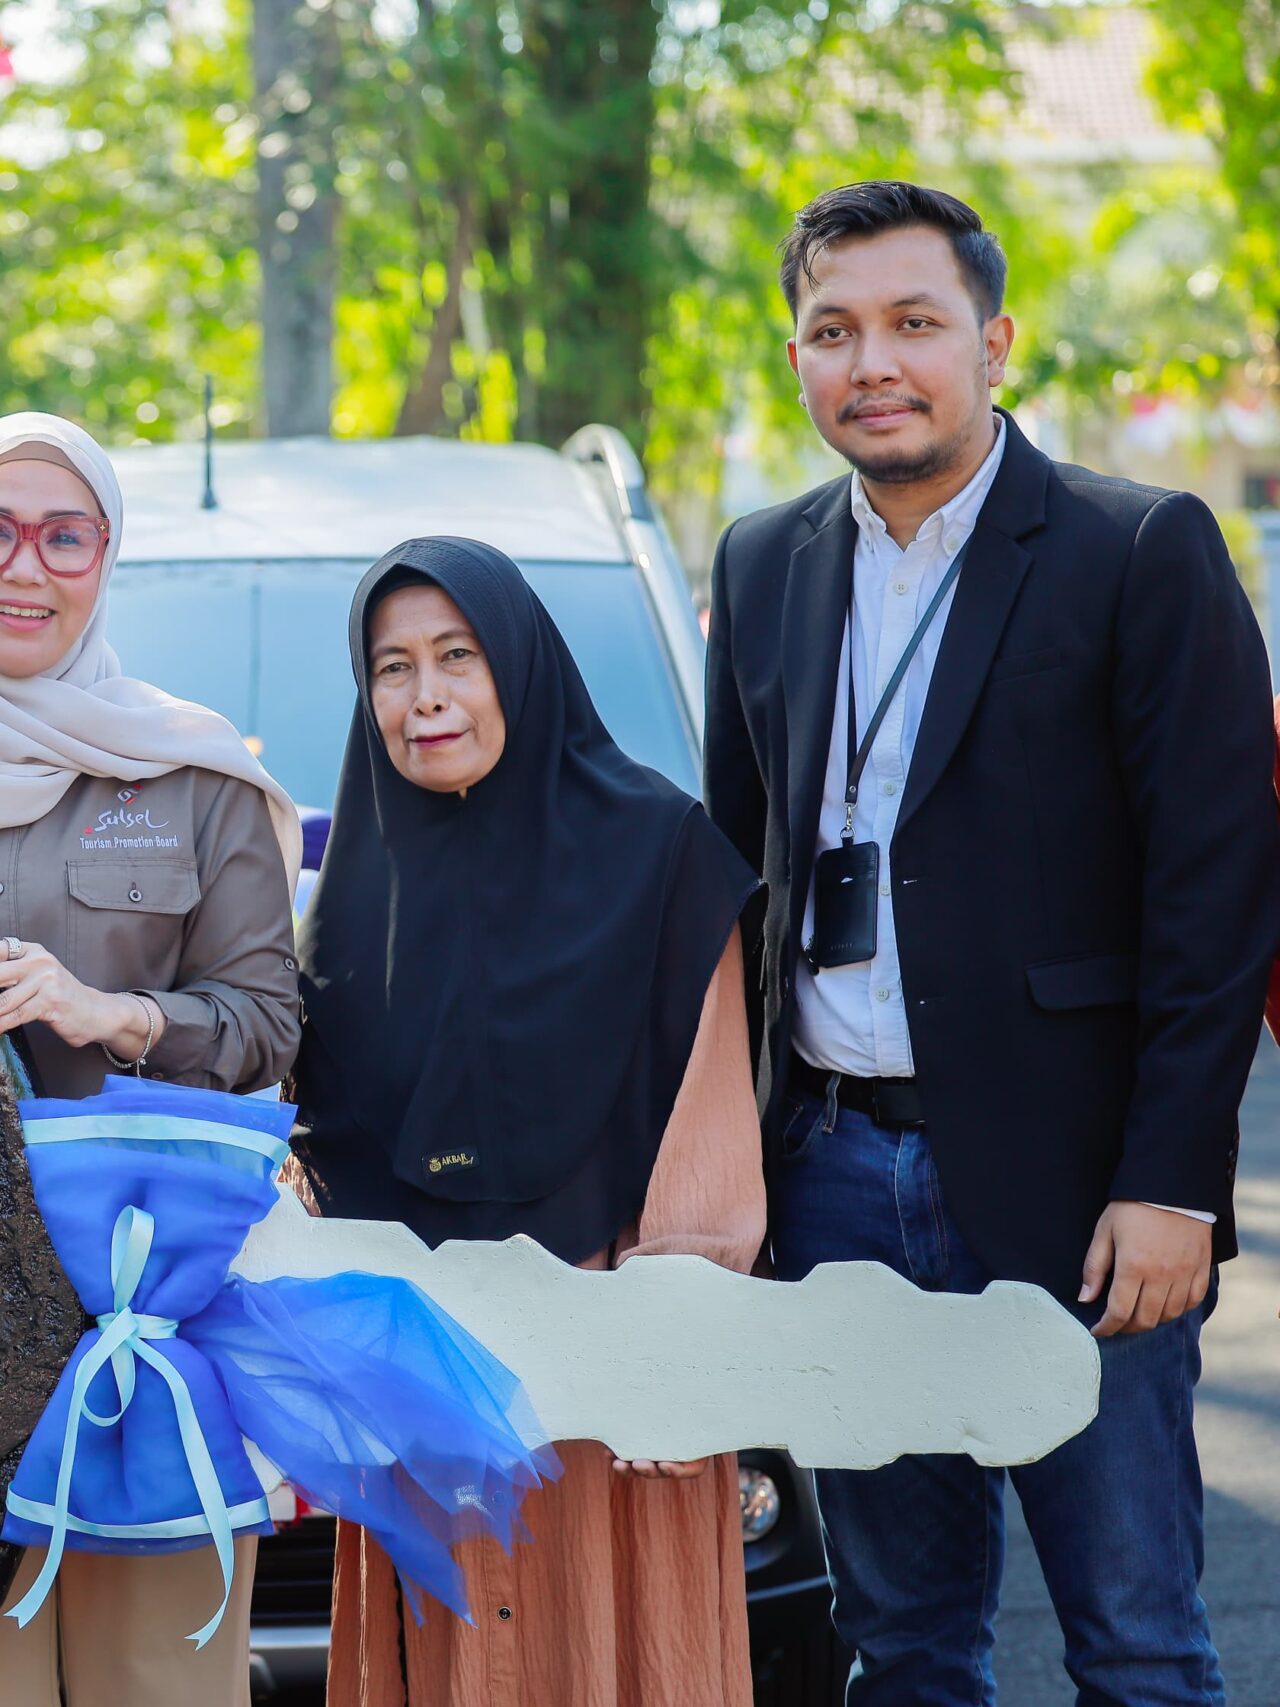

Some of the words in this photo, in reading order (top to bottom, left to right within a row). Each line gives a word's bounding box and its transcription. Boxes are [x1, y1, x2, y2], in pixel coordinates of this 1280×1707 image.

[80, 837, 112, 849] Tourism
[113, 836, 154, 849] Promotion
[155, 835, 178, 847] Board
[442, 1153, 468, 1166] AKBAR
